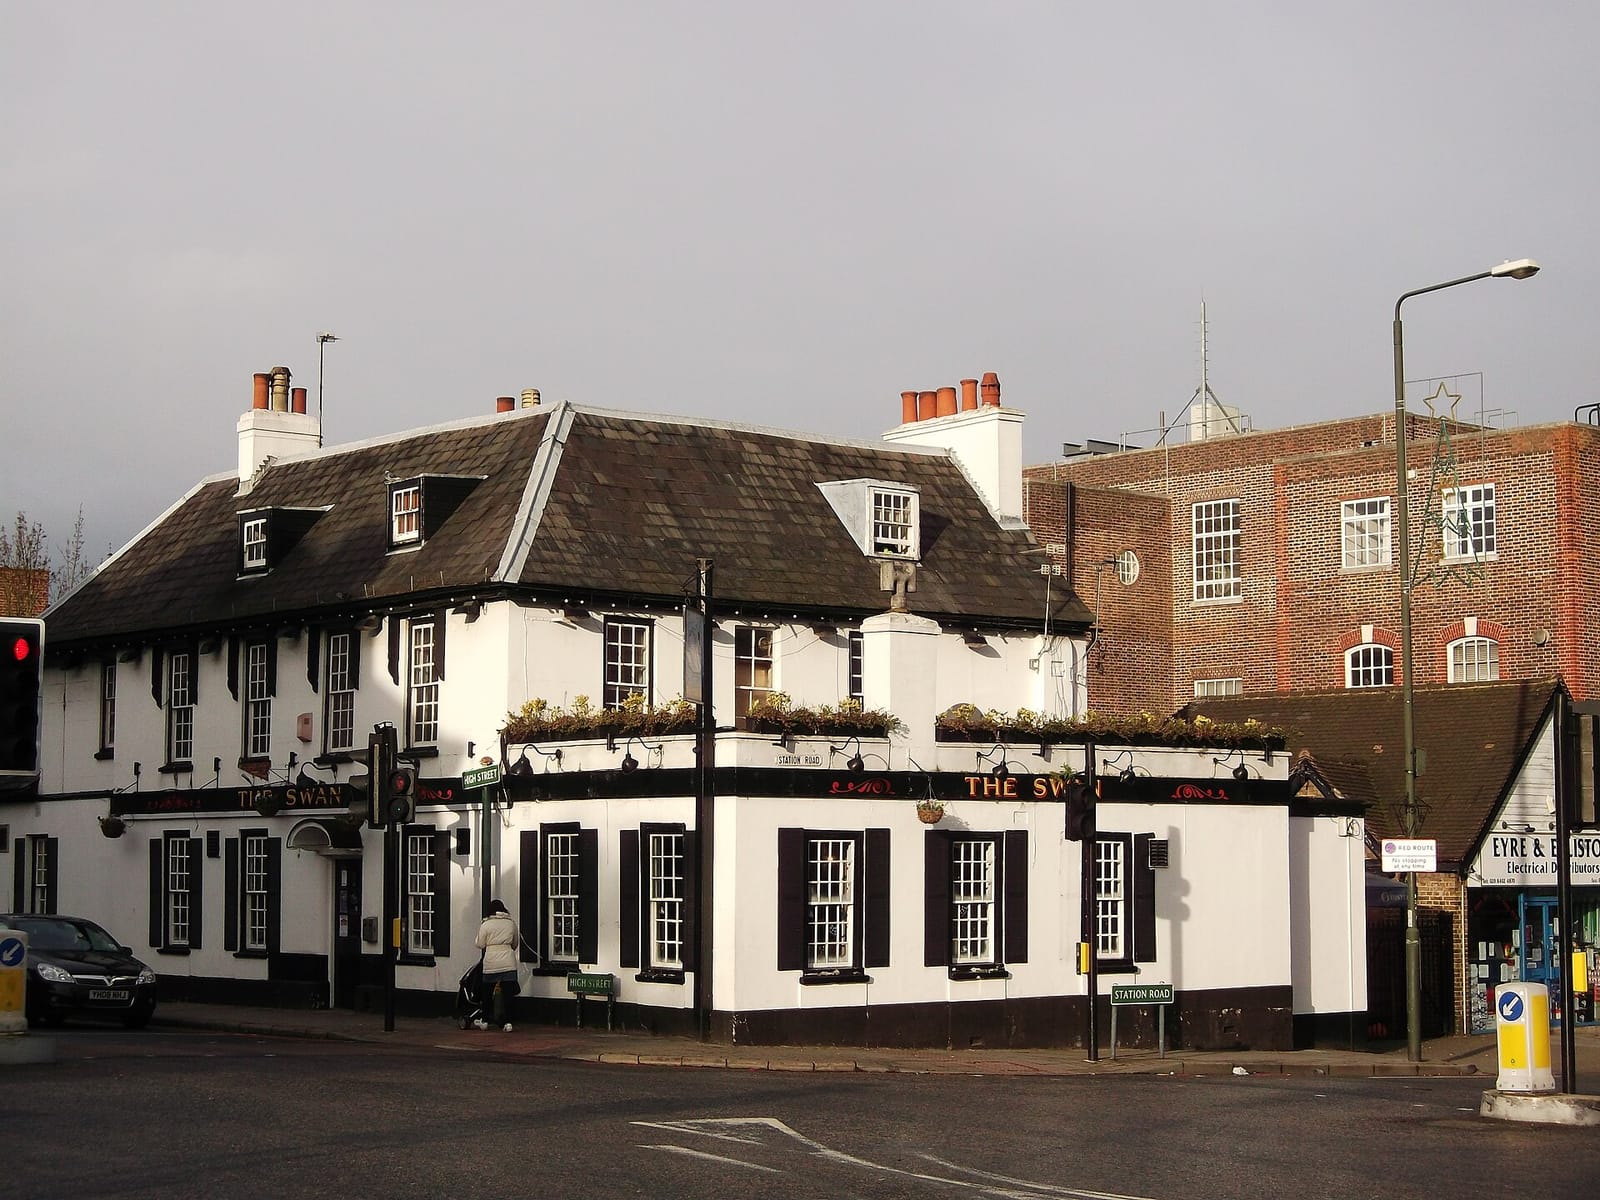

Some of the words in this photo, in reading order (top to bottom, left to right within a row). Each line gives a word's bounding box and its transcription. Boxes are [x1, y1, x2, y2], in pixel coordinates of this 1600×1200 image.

[778, 756, 801, 764] STATION
[805, 756, 820, 764] ROAD
[464, 773, 477, 785] HIGH
[477, 769, 497, 782] STREET
[964, 776, 1018, 798] THE
[1033, 777, 1102, 799] SW
[286, 787, 341, 806] SWAN
[1493, 837, 1528, 858] EYRE
[1533, 838, 1546, 858] &
[1551, 838, 1600, 858] EISTO
[1507, 861, 1548, 874] Electrical
[1551, 861, 1600, 874] Dibutors
[570, 978, 587, 988] HIGH
[587, 979, 612, 989] STREET
[1114, 989, 1147, 1000] STATION
[1149, 989, 1170, 999] ROAD
